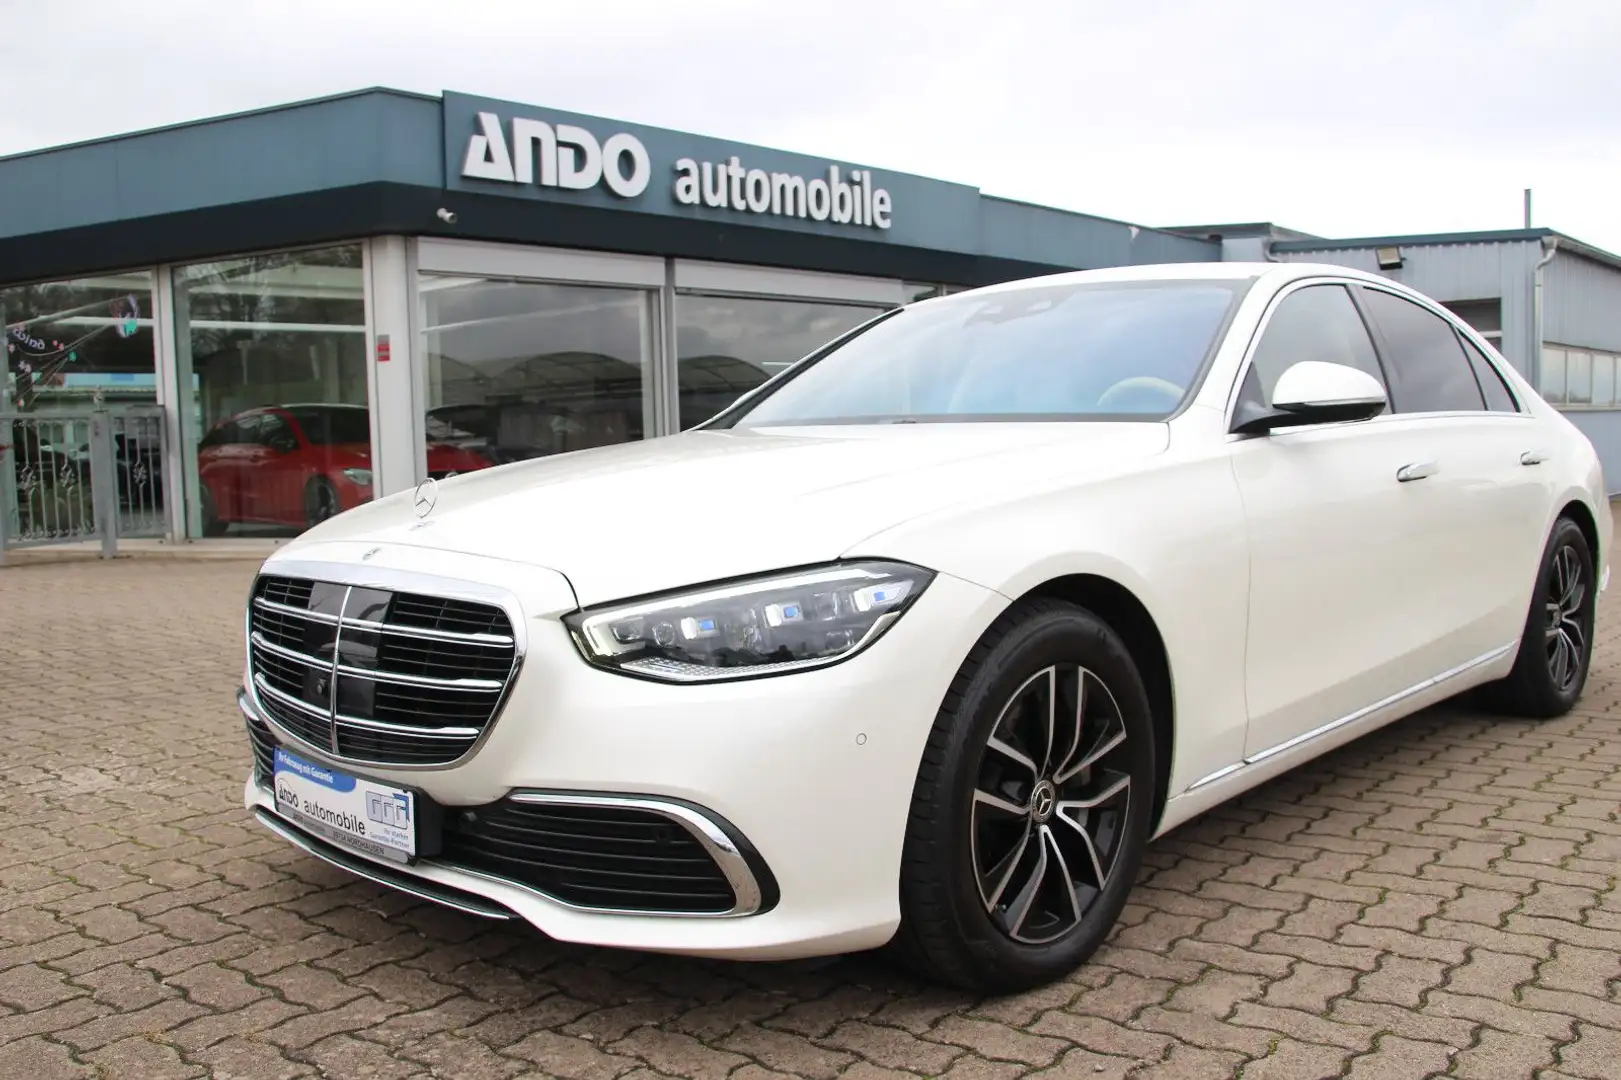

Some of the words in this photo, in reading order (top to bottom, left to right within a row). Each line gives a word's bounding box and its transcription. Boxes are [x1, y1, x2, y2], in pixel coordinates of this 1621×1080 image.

[462, 112, 651, 197] ANDO
[674, 156, 892, 229] automobile
[311, 766, 334, 783] Garantie
[303, 799, 366, 835] automobile
